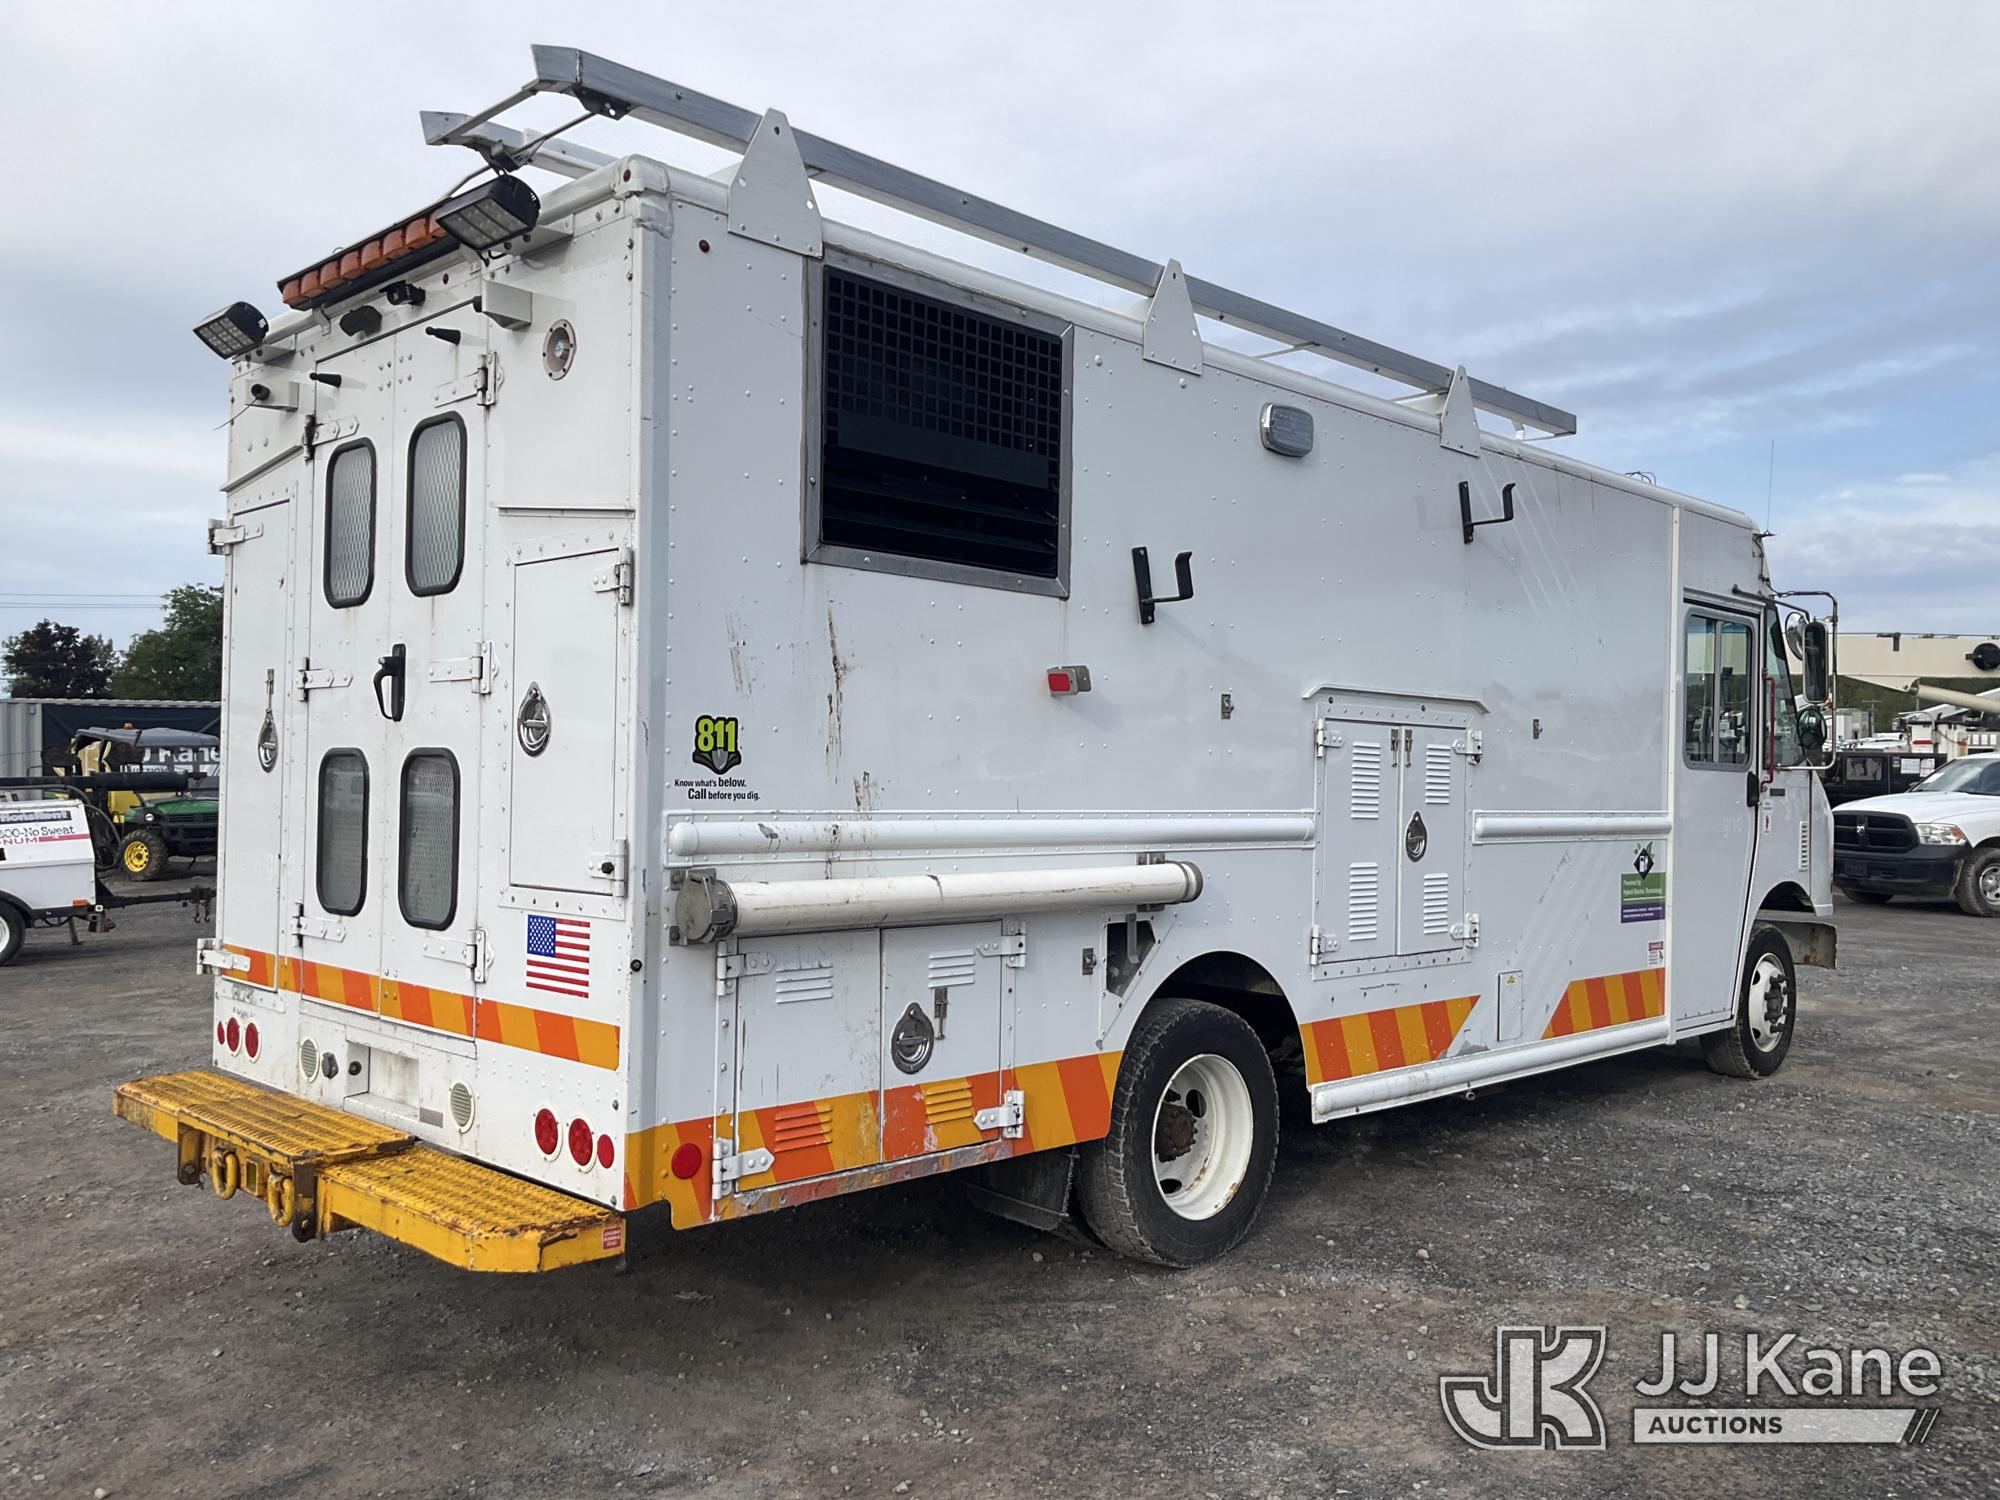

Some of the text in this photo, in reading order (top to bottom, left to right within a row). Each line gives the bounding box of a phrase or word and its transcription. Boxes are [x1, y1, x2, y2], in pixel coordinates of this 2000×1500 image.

[697, 717, 736, 752] 811
[674, 777, 747, 787] Know what's below.
[688, 788, 760, 801] Call before you dig.
[41, 826, 76, 836] Sweat
